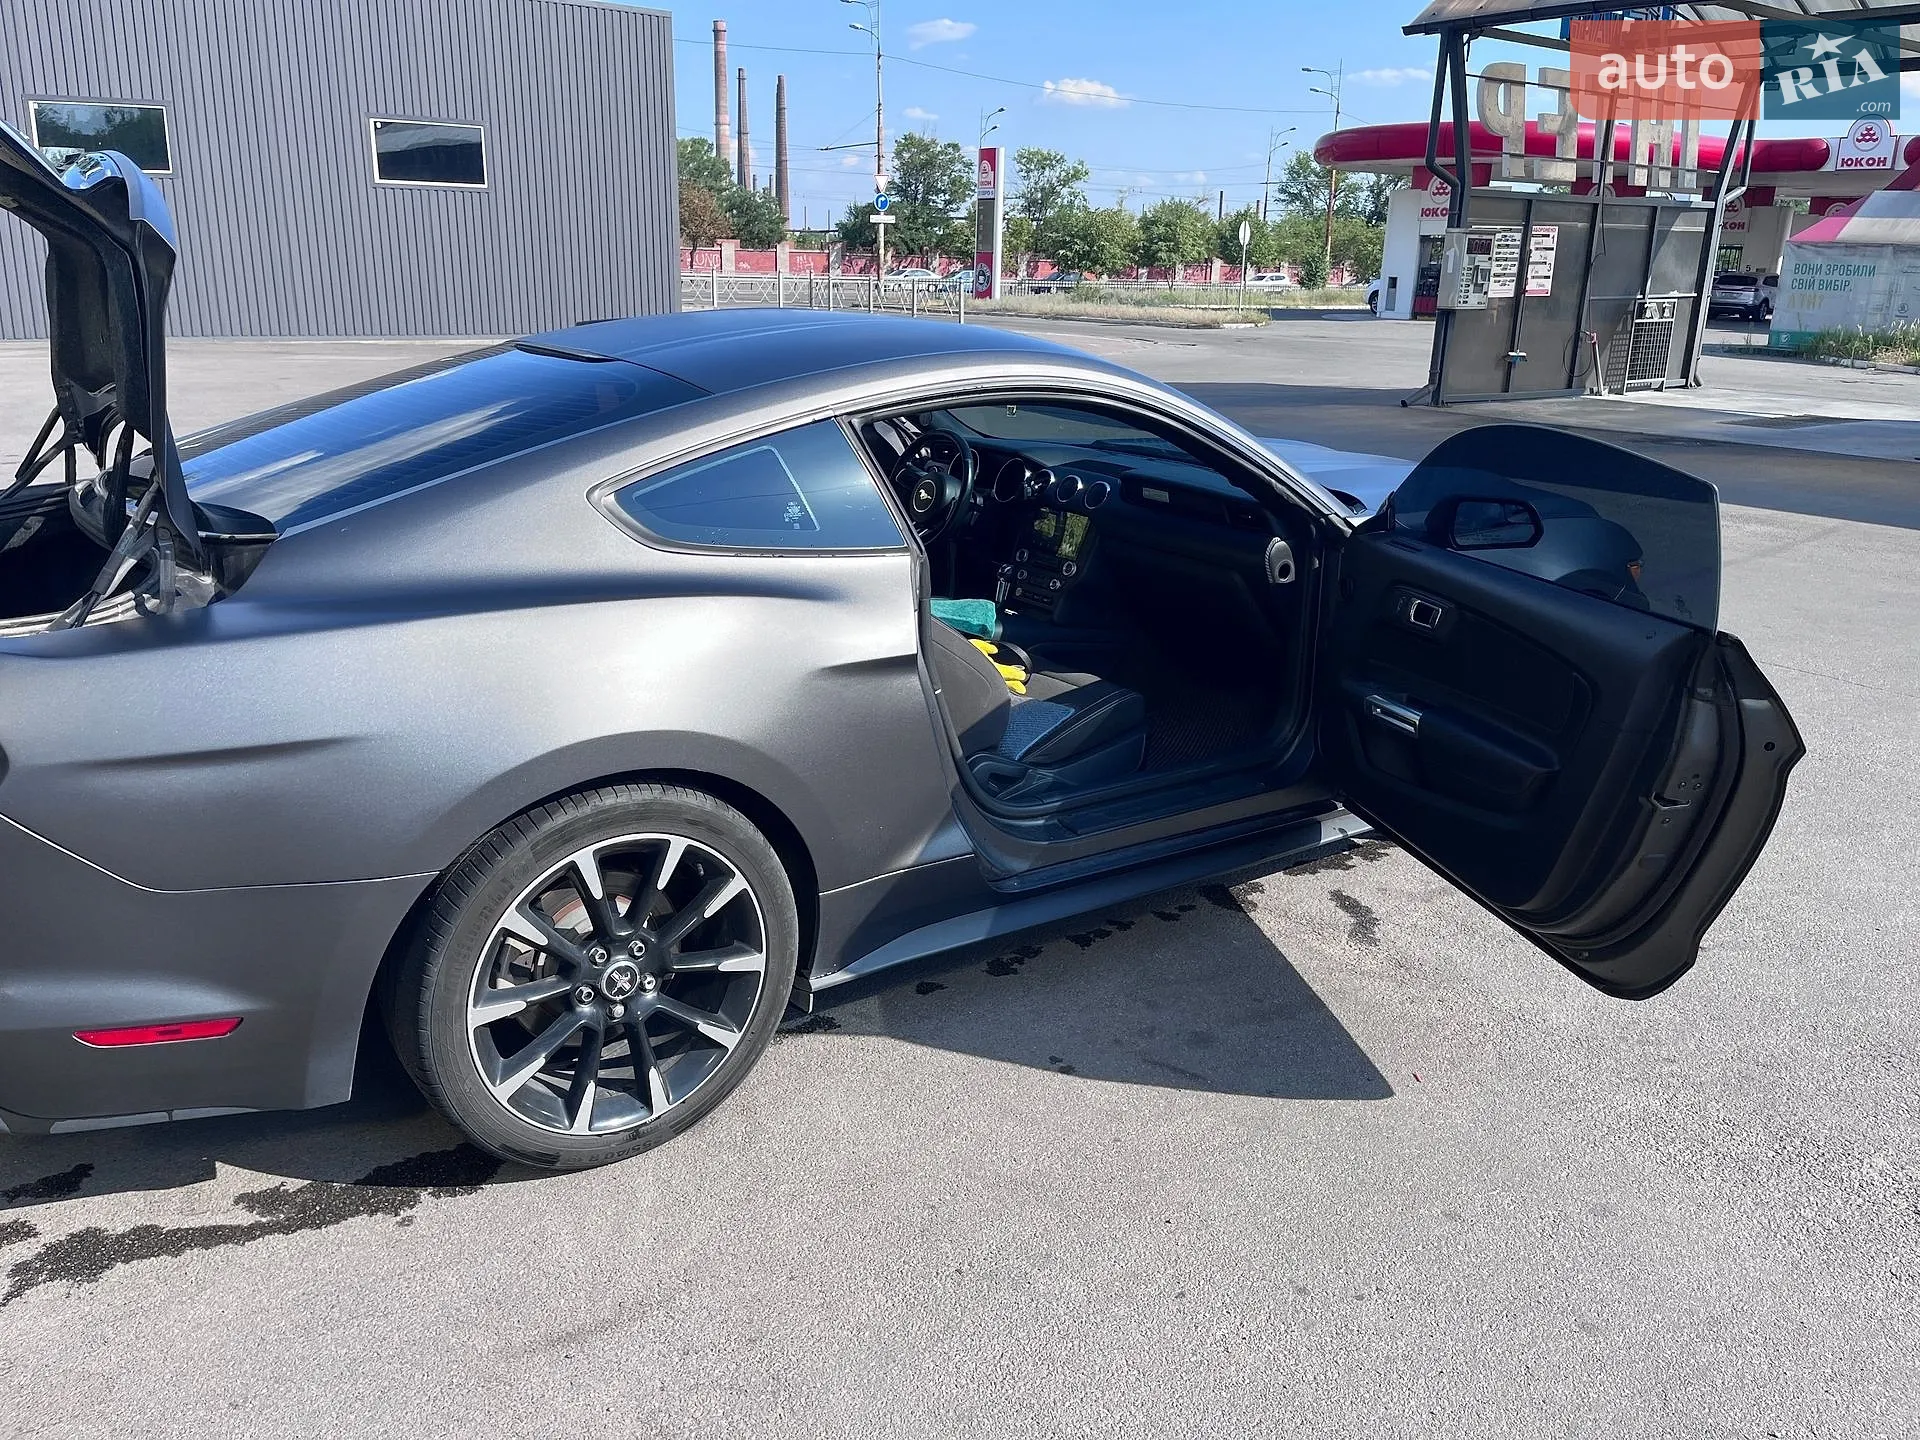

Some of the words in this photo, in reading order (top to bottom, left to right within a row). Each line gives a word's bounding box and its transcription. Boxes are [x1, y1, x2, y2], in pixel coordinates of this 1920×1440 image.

[1840, 157, 1888, 168] ЮКОН
[1420, 207, 1449, 218] ЮКО
[1722, 221, 1746, 231] КОН
[1445, 247, 1455, 273] 1
[1793, 263, 1823, 276] ВОНИ
[1825, 263, 1877, 278] ЗРОБИЛИ
[1791, 276, 1816, 290] СВІЙ
[1818, 278, 1852, 292] ВИБІР.
